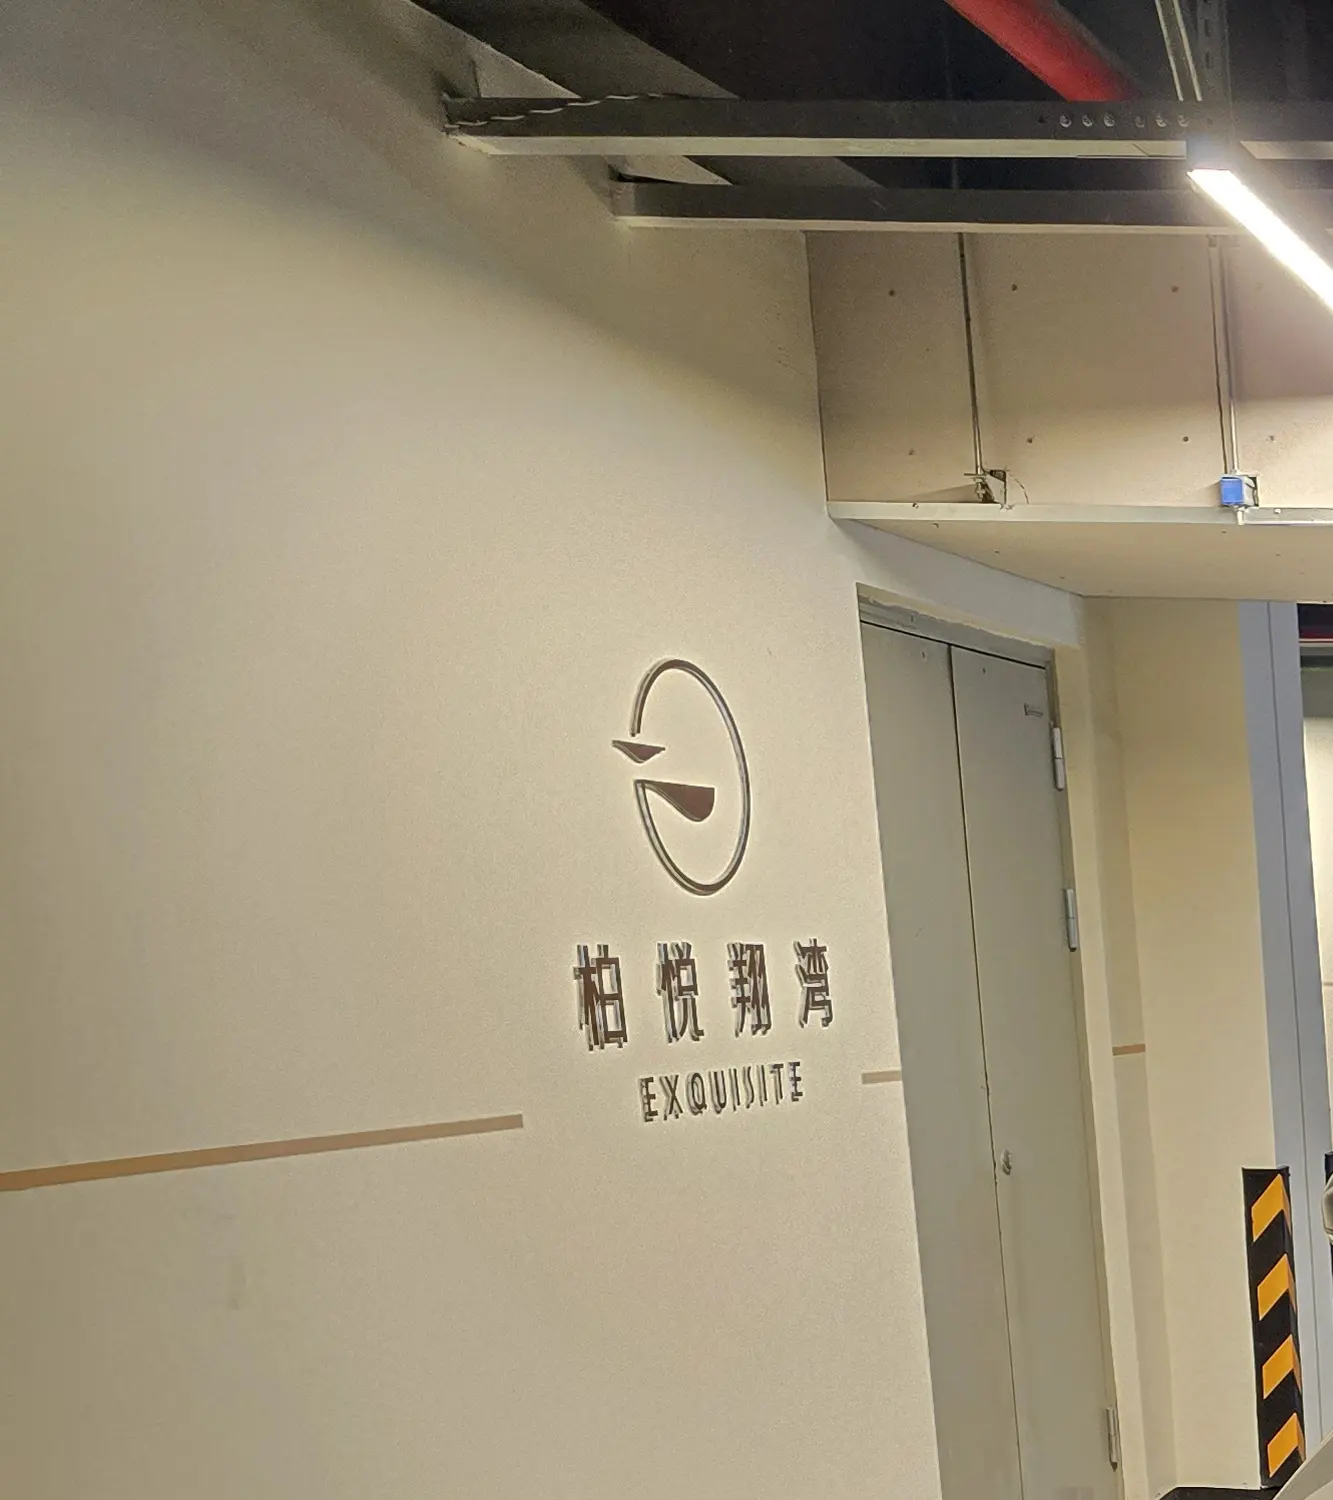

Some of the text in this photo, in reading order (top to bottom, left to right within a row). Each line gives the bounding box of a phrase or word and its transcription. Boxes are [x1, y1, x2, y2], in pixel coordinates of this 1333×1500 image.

[573, 938, 834, 1051] 柏悦翔湾
[639, 1061, 804, 1122] EXQUISITE
